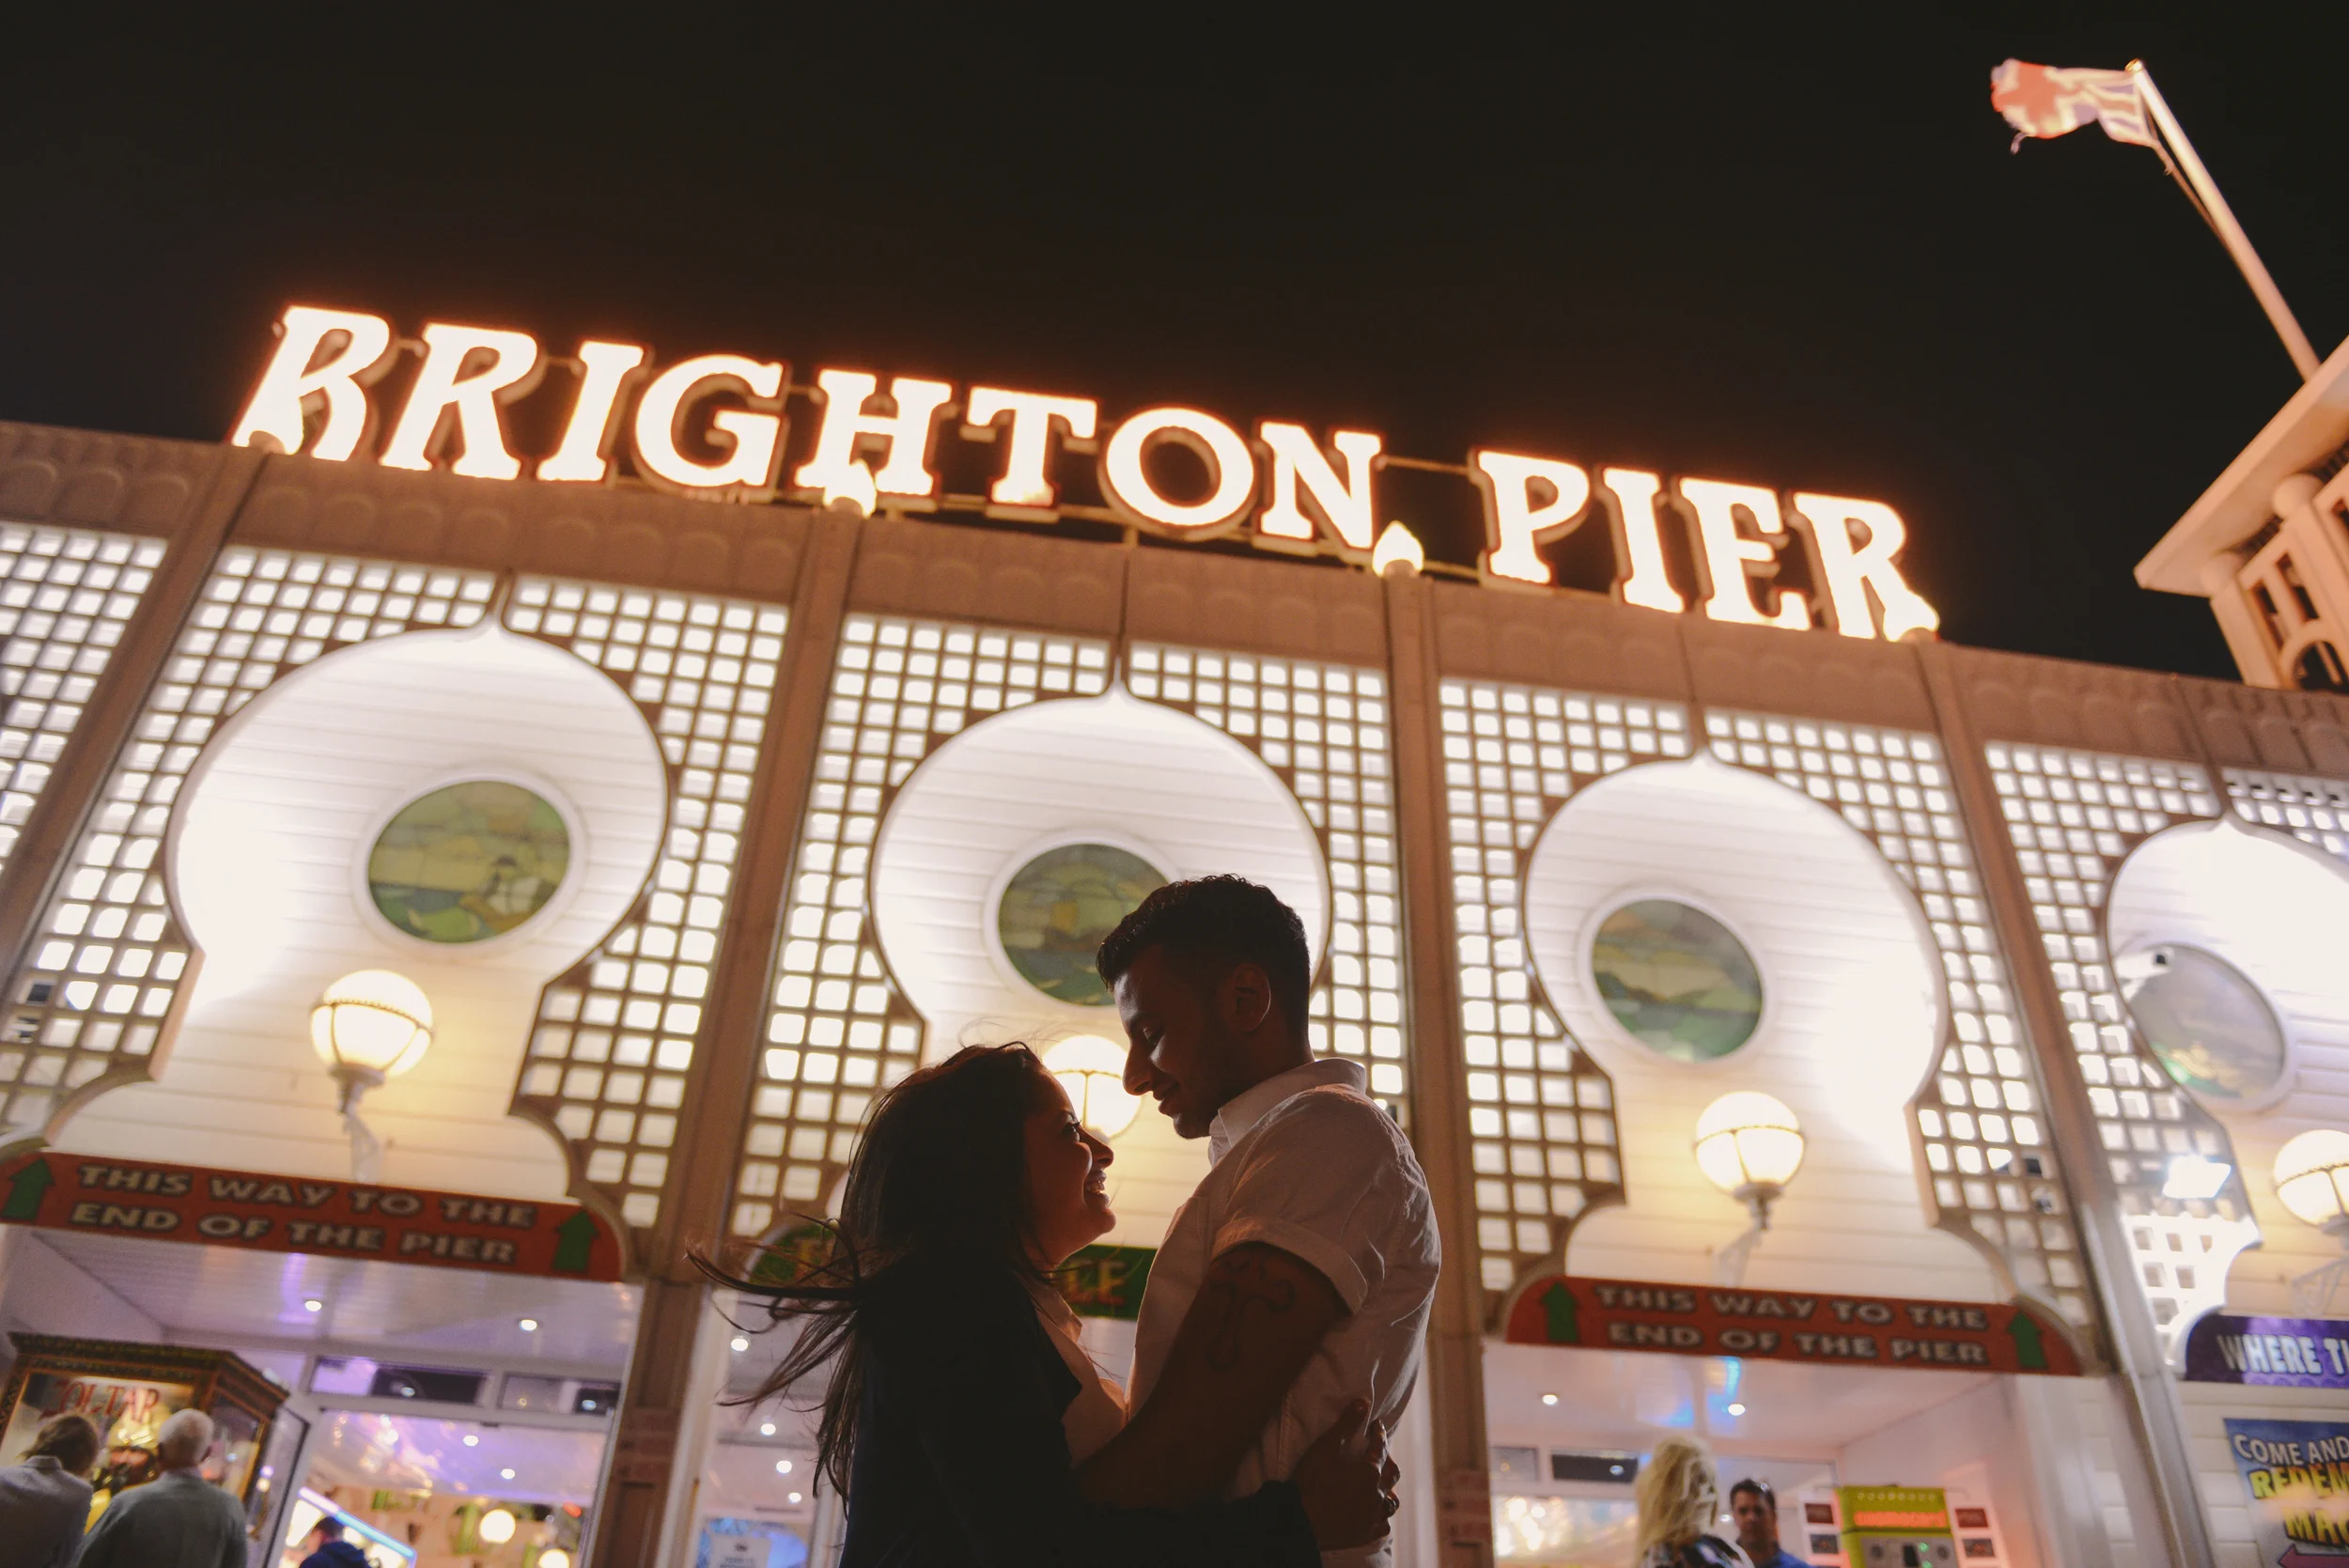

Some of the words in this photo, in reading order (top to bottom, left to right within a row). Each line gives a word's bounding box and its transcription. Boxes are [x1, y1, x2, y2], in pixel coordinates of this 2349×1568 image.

[230, 303, 1384, 551] BRIGHTON
[1472, 449, 1937, 642] PIER
[80, 1164, 192, 1196] THIS
[210, 1178, 334, 1207] WAY
[350, 1189, 422, 1216] TO
[442, 1198, 537, 1228] THE
[70, 1203, 180, 1231] END
[199, 1214, 272, 1241] OF
[288, 1220, 384, 1250] THE
[399, 1231, 516, 1264] PIER
[1595, 1285, 1696, 1312] THIS
[1710, 1293, 1817, 1319] WAY
[1829, 1300, 1892, 1326] TO
[1906, 1305, 1989, 1331] THE
[1608, 1322, 1703, 1347] END
[1719, 1328, 1780, 1353] OF
[1794, 1333, 1878, 1358] THE
[1890, 1338, 1990, 1364] PIER
[2216, 1334, 2323, 1374] WHERE
[2233, 1434, 2304, 1467] COME
[2308, 1436, 2349, 1465] AND
